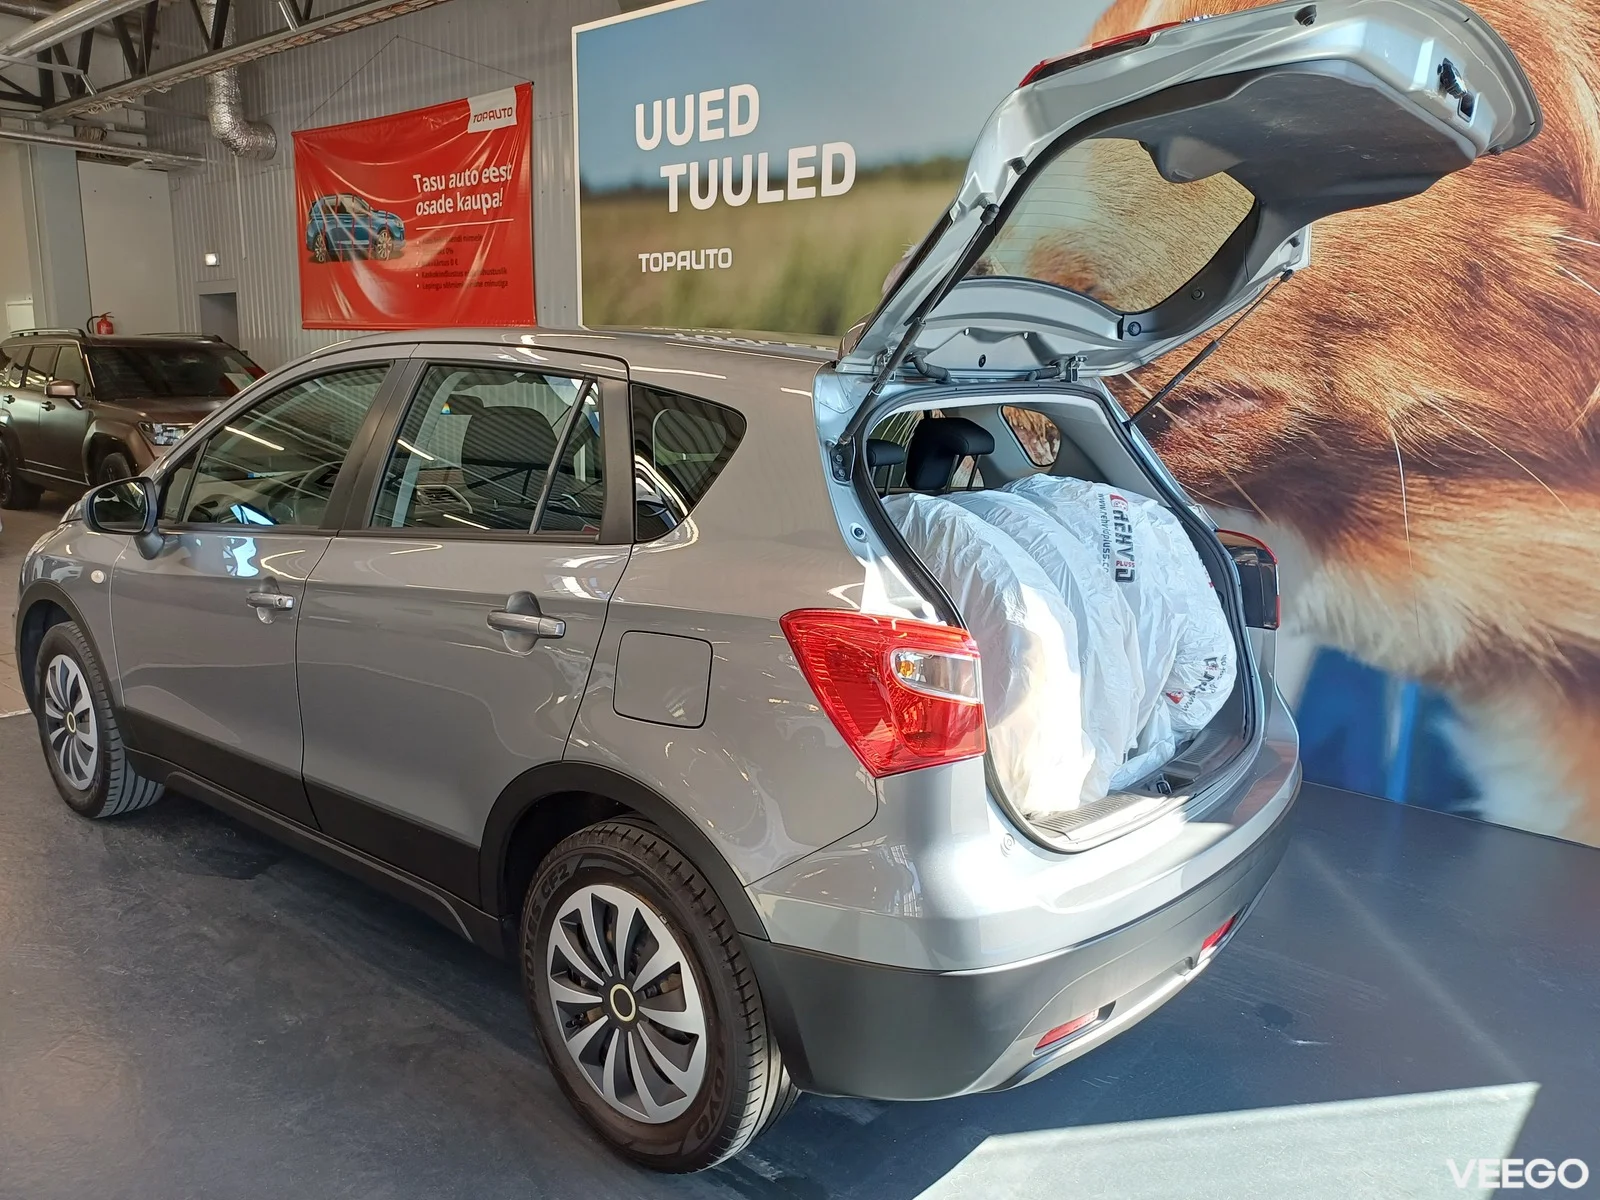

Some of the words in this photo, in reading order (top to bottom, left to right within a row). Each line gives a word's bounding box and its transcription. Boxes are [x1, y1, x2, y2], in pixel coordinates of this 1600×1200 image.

[473, 107, 513, 123] TOPAUTO
[634, 83, 760, 151] UUED
[413, 174, 446, 193] Tasu
[448, 169, 479, 189] auto
[481, 162, 512, 184] eest
[660, 141, 856, 213] TUULED
[416, 194, 454, 216] osade
[456, 187, 504, 215] kaupa!
[638, 247, 733, 273] TOPAUTO
